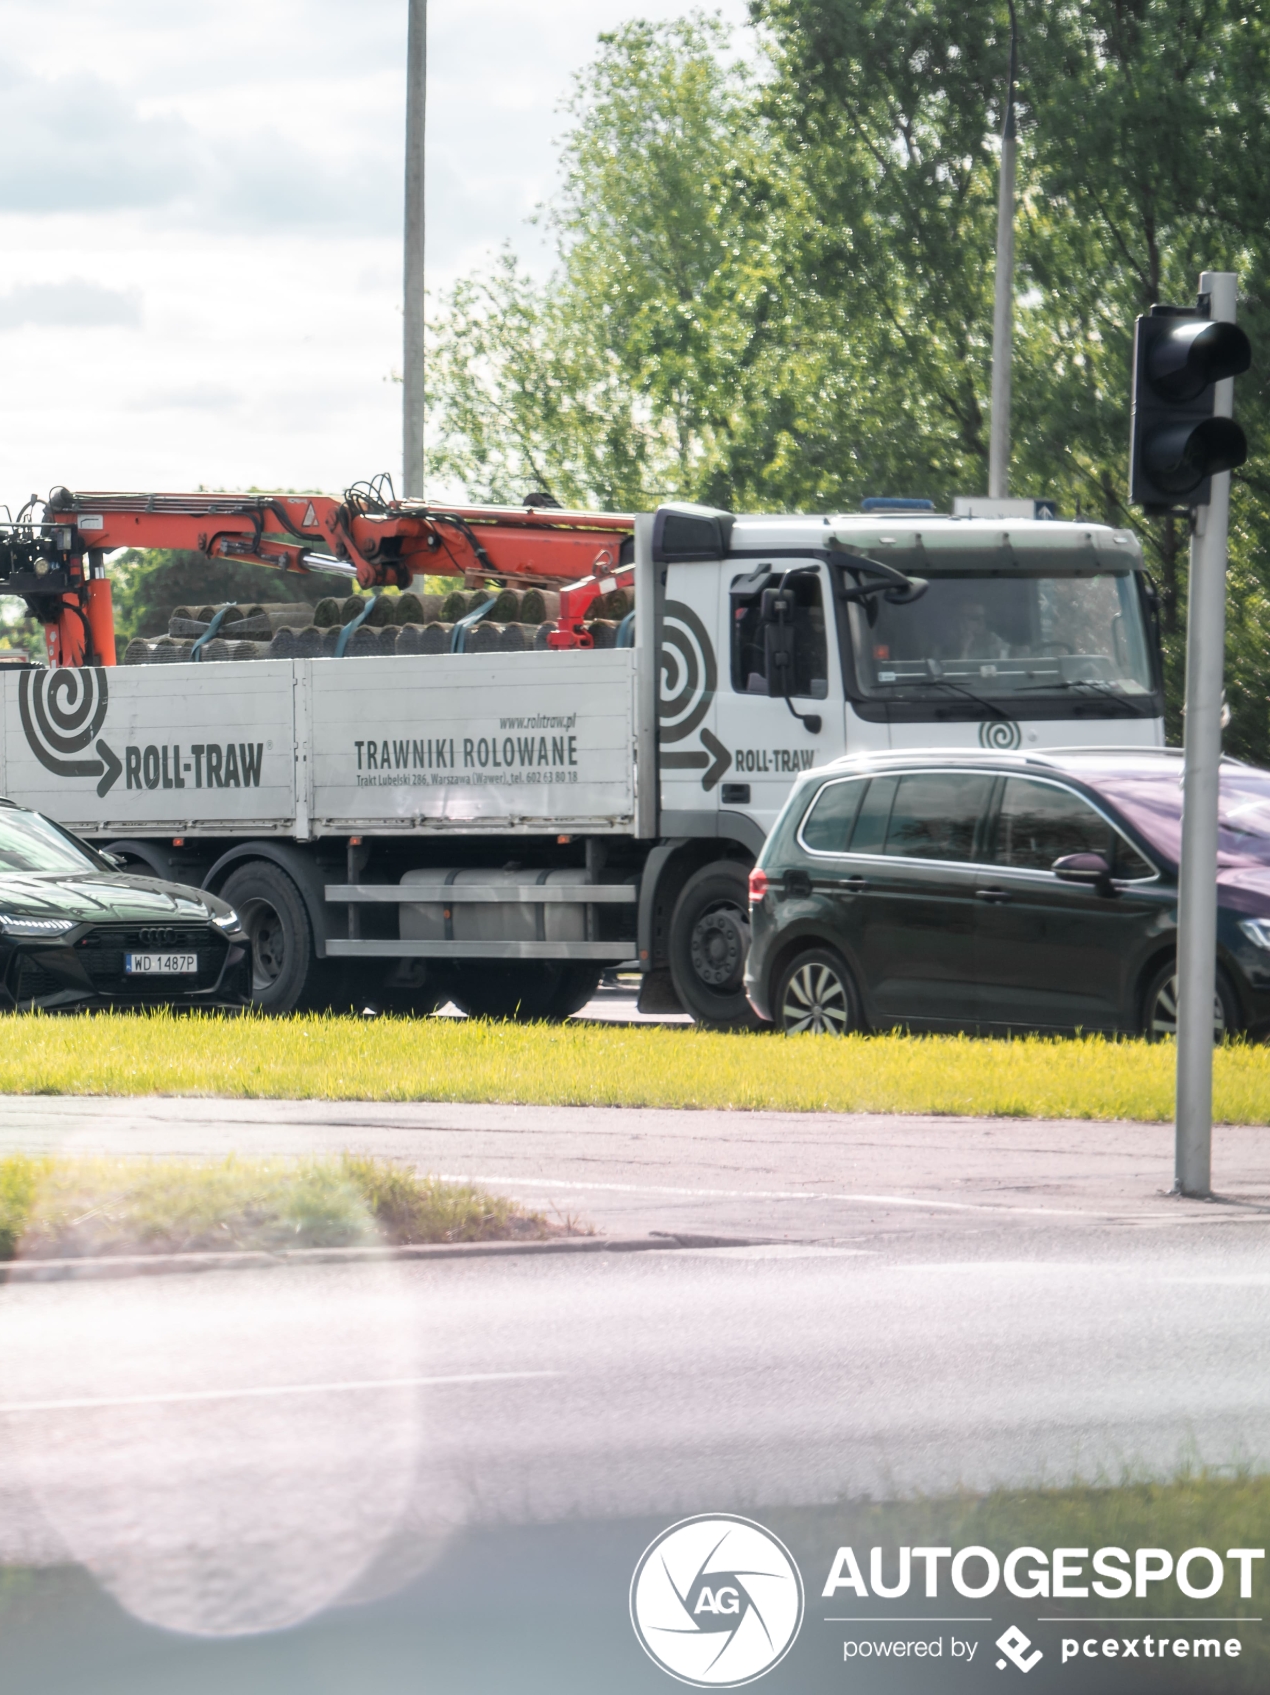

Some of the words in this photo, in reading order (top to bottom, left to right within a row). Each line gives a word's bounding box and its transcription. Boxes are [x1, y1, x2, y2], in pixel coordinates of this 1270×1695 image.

[355, 738, 454, 770] TRAWNIKI
[463, 736, 578, 768] ROLOWANE
[735, 749, 814, 772] ROLL-TRAW
[125, 743, 264, 789] ROLL-TRAW
[357, 775, 376, 787] Trakt
[378, 774, 410, 786] Lubelski
[412, 774, 429, 786] 286,
[431, 773, 470, 785] Warszawa
[511, 771, 525, 783] tel.
[526, 772, 541, 783] 602
[543, 772, 553, 783] 63
[555, 771, 566, 782] 80
[568, 771, 578, 782] 18
[134, 956, 152, 971] WD
[157, 956, 194, 971] 1487P
